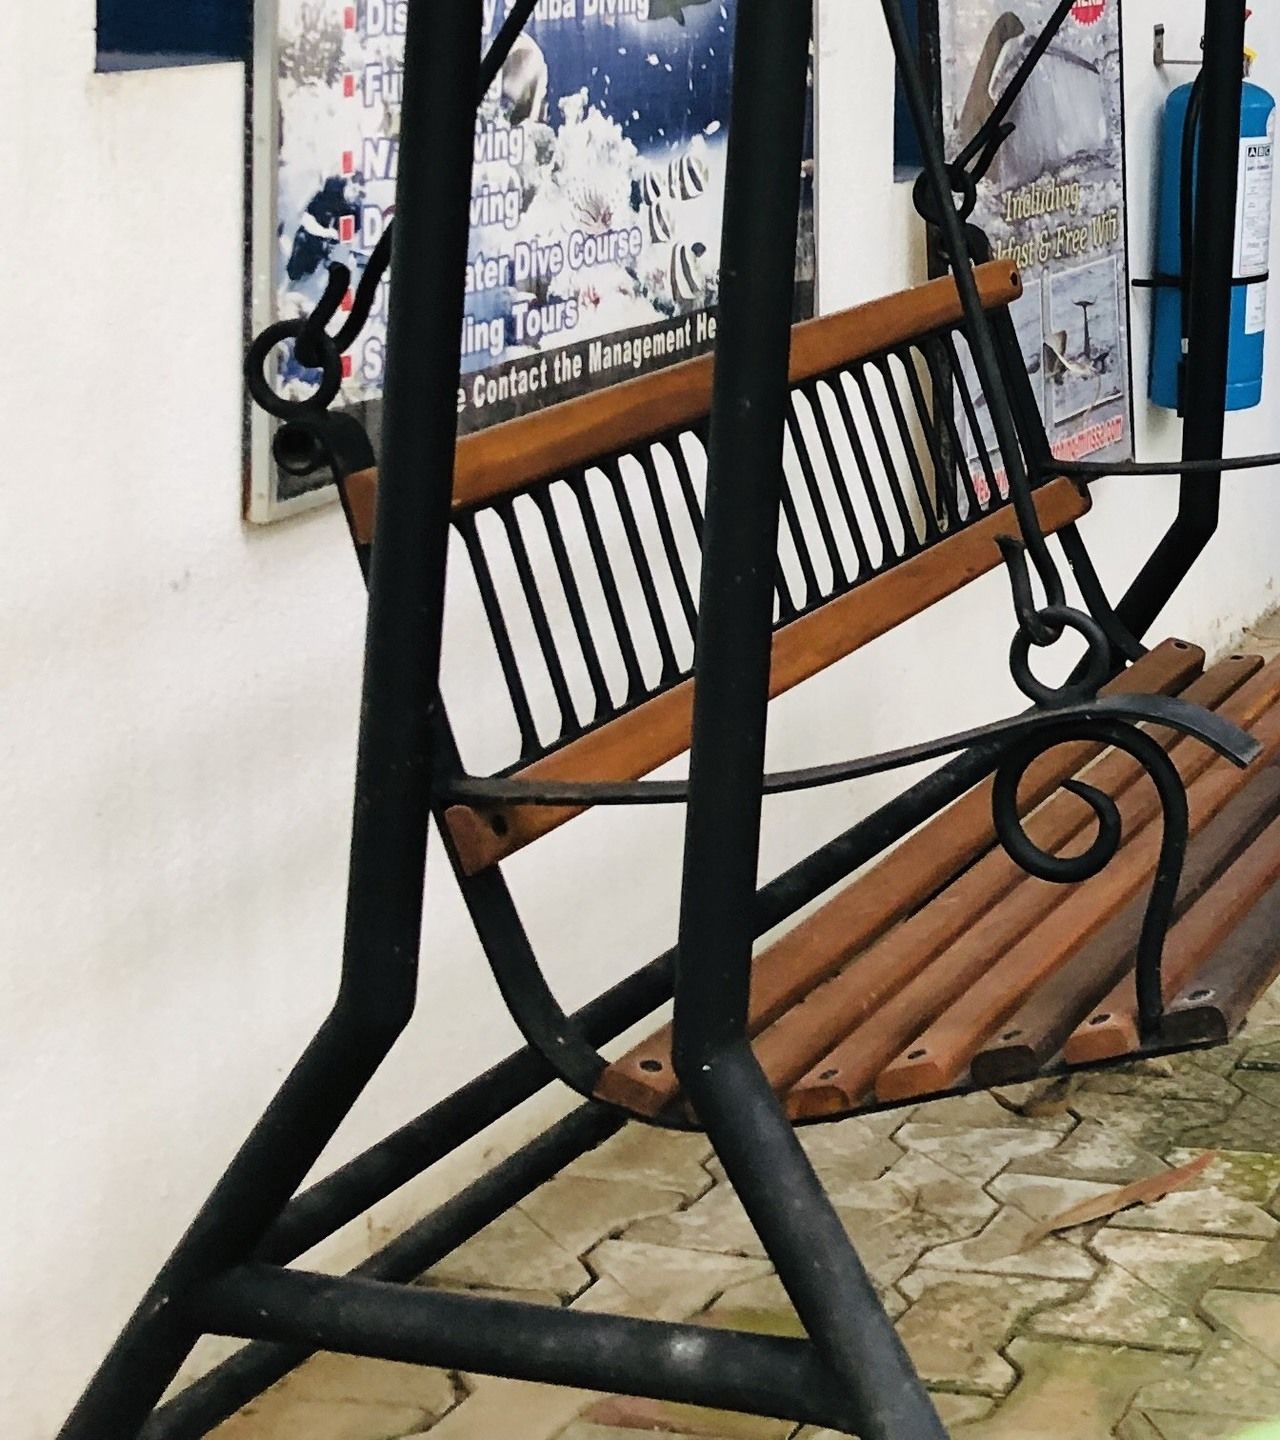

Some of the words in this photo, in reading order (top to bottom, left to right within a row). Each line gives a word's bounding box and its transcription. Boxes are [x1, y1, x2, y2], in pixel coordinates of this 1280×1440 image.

[1003, 177, 1080, 223] Including
[513, 240, 564, 283] Dive
[567, 226, 643, 271] Course
[1038, 229, 1051, 263] &
[1055, 224, 1089, 258] Free
[511, 297, 580, 342] Tours
[472, 358, 548, 409] Contact
[553, 351, 583, 385] the
[588, 315, 692, 374] Management
